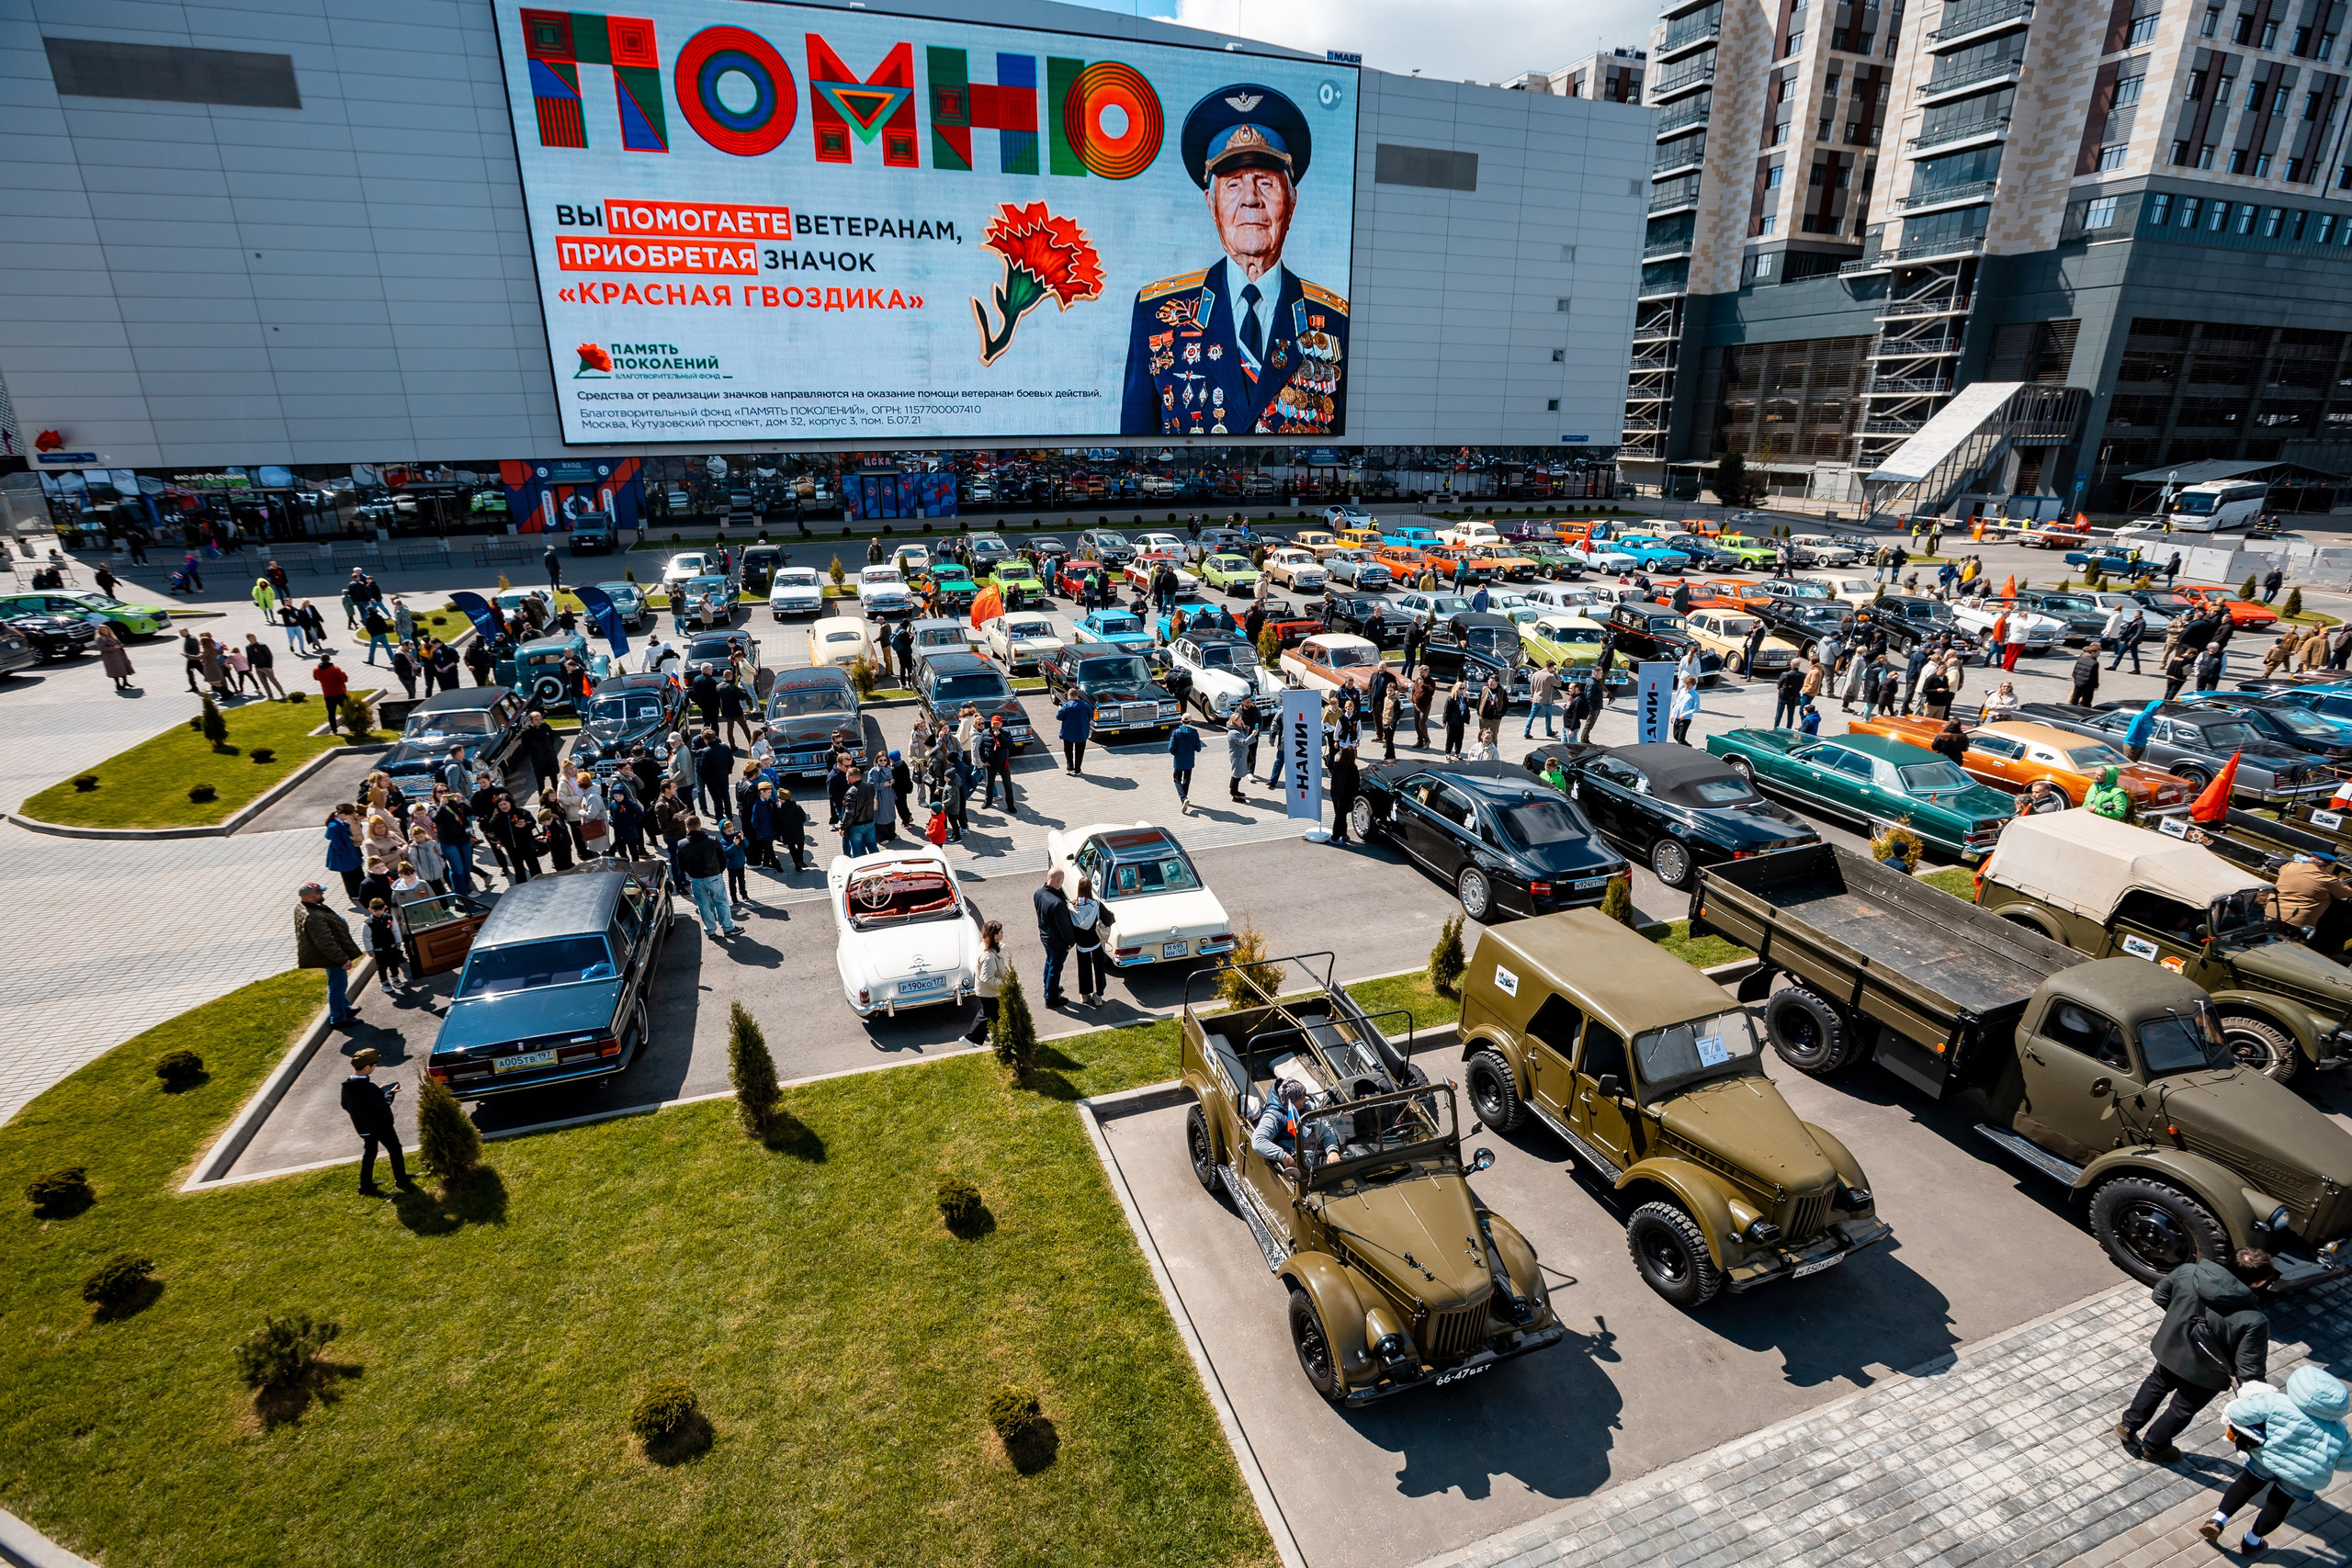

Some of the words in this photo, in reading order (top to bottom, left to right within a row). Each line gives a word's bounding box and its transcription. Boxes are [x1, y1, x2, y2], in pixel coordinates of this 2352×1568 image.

[1334, 52, 1362, 64] MAER
[520, 7, 1164, 180] ПОМНЮ
[1319, 84, 1342, 105] 0+
[555, 204, 604, 228] ВЫ
[610, 207, 789, 234] ПОМОГАЕТЕ
[795, 214, 962, 244] ВЕТЕРАНАМ,
[561, 243, 756, 270] ПРИОБРЕТАЯ
[763, 249, 876, 273] ЗНАЧОК
[558, 281, 732, 308] «КРАСНАЯ
[743, 285, 924, 312] ГВОЗДИКА»
[611, 344, 679, 355] ПАМЯТЬ
[613, 355, 719, 369] ПОКОЛЕНИЙ
[577, 390, 634, 401] Средства
[637, 391, 650, 400] от
[652, 390, 720, 401] реализации
[723, 390, 768, 399] значков
[771, 390, 849, 401] направляются
[866, 389, 915, 398] оказание
[918, 389, 959, 399] помощи
[961, 389, 1013, 399] ветеранам
[1016, 389, 1053, 398] боевых
[1055, 389, 1102, 399] действий.
[580, 408, 698, 420] Благотворительный
[700, 407, 732, 419] фонд
[735, 406, 788, 416] «ПАМЯТЬ
[790, 404, 869, 416] ПОКОЛЕНИЙ»,
[871, 405, 902, 414] ОГРН:
[905, 405, 982, 414] 1157700007410
[582, 420, 628, 429] Москва,
[631, 418, 706, 430] Кутузовский
[707, 418, 763, 429] проспект,
[765, 418, 787, 427] дом
[790, 417, 806, 427] 32,
[808, 417, 847, 427] корпус
[849, 416, 858, 426] 3,
[861, 417, 884, 425] пом.
[887, 416, 922, 424] Б.07.21
[864, 457, 891, 467] ЦСКА
[1646, 692, 1658, 743] АМИ
[537, 1051, 551, 1059] 197
